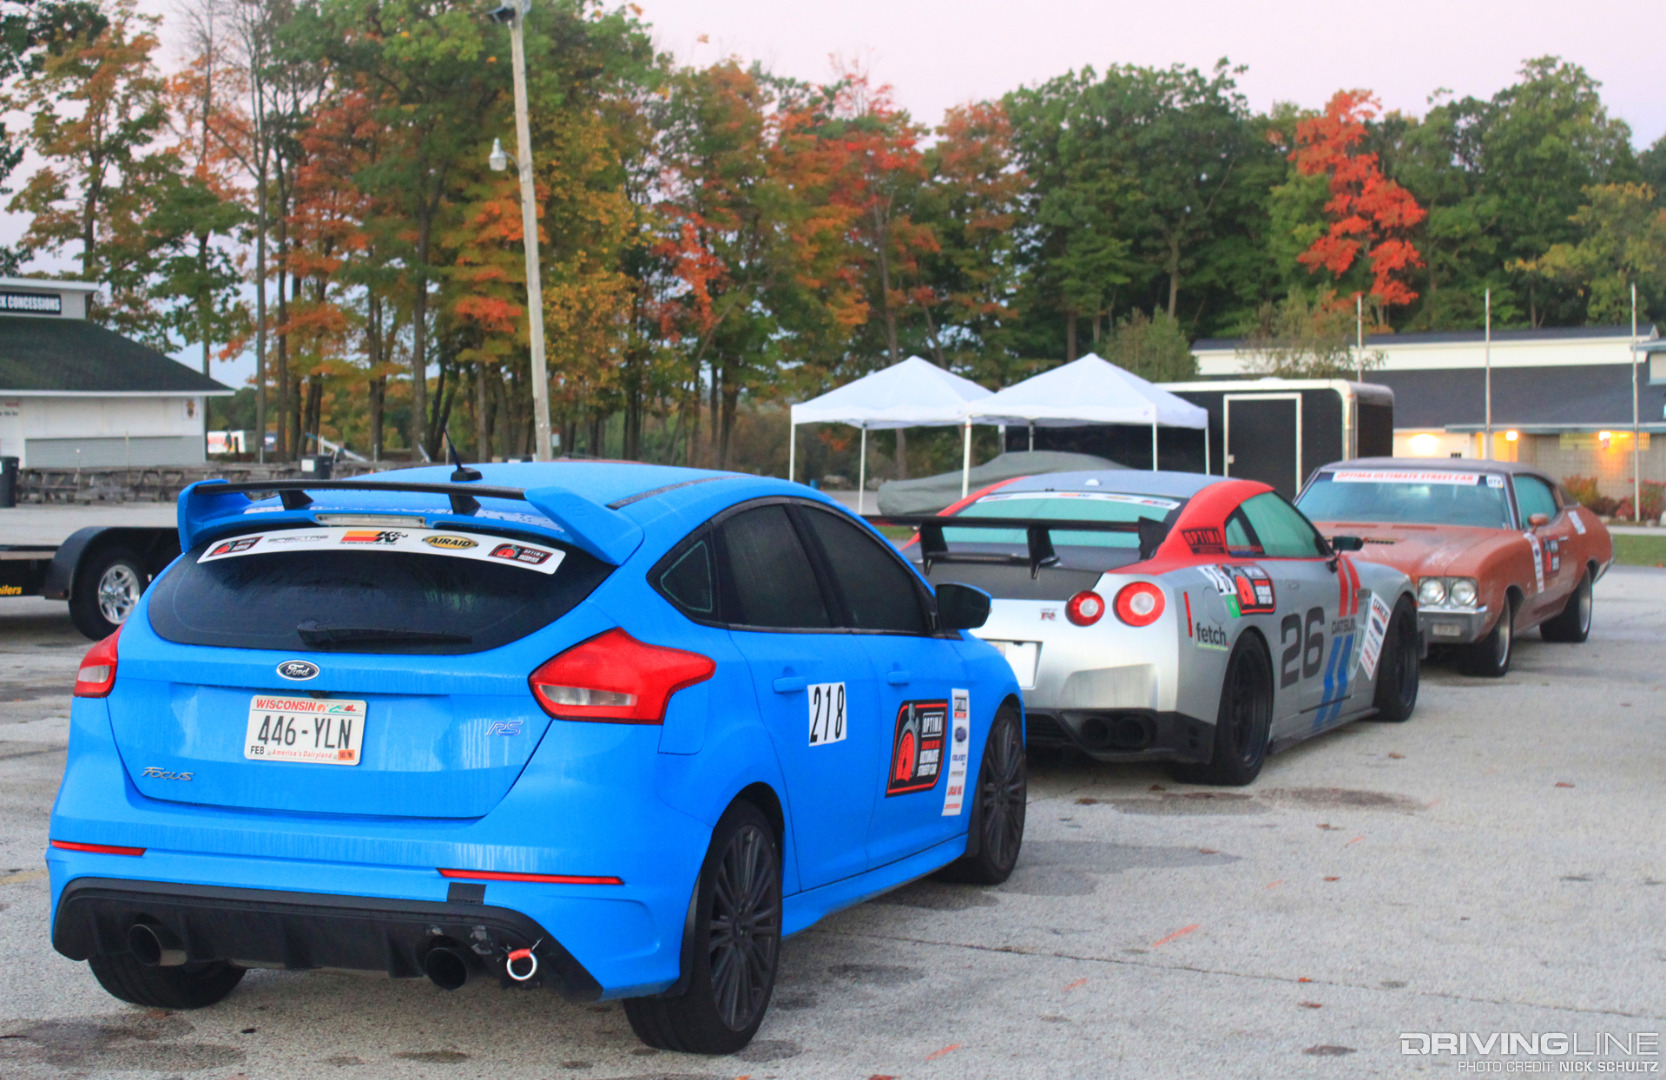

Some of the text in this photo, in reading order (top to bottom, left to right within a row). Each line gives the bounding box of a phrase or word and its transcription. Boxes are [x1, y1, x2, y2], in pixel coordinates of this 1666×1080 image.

[8, 295, 60, 311] CONCESSIONS
[1338, 471, 1474, 482] OPTIMA ULTIMATE STREET CAR
[430, 537, 471, 548] AIRAID
[1281, 606, 1325, 689] 26
[285, 662, 310, 677] Ford
[256, 699, 317, 712] WISCONSIN
[809, 684, 845, 743] 218
[257, 715, 352, 750] 446-YLN
[486, 720, 524, 736] RS
[250, 745, 265, 755] FEB
[272, 748, 333, 760] America's Dairyland
